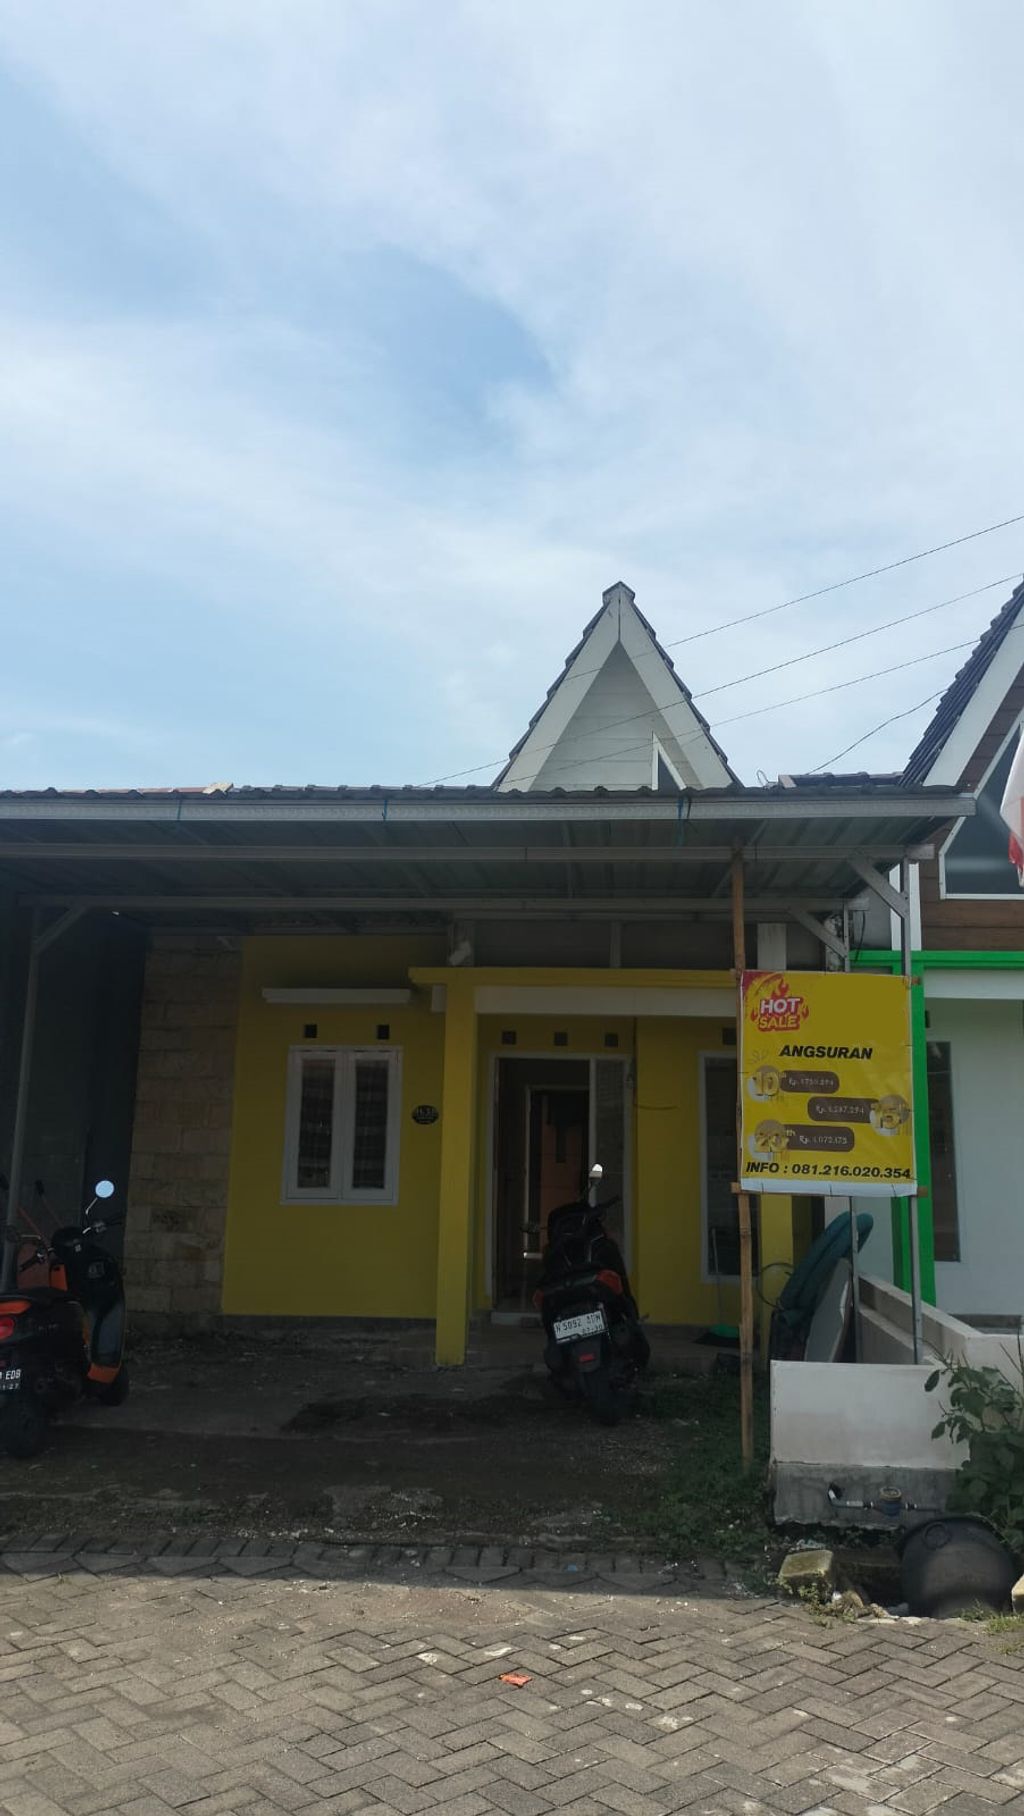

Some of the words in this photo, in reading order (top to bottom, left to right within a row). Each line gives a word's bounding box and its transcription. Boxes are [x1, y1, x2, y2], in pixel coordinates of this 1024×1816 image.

[760, 997, 801, 1014] HOT
[759, 1014, 797, 1028] SALE
[779, 1045, 873, 1060] ANGSURAN
[746, 1162, 780, 1174] INFO
[791, 1163, 912, 1179] 081.216.020.354
